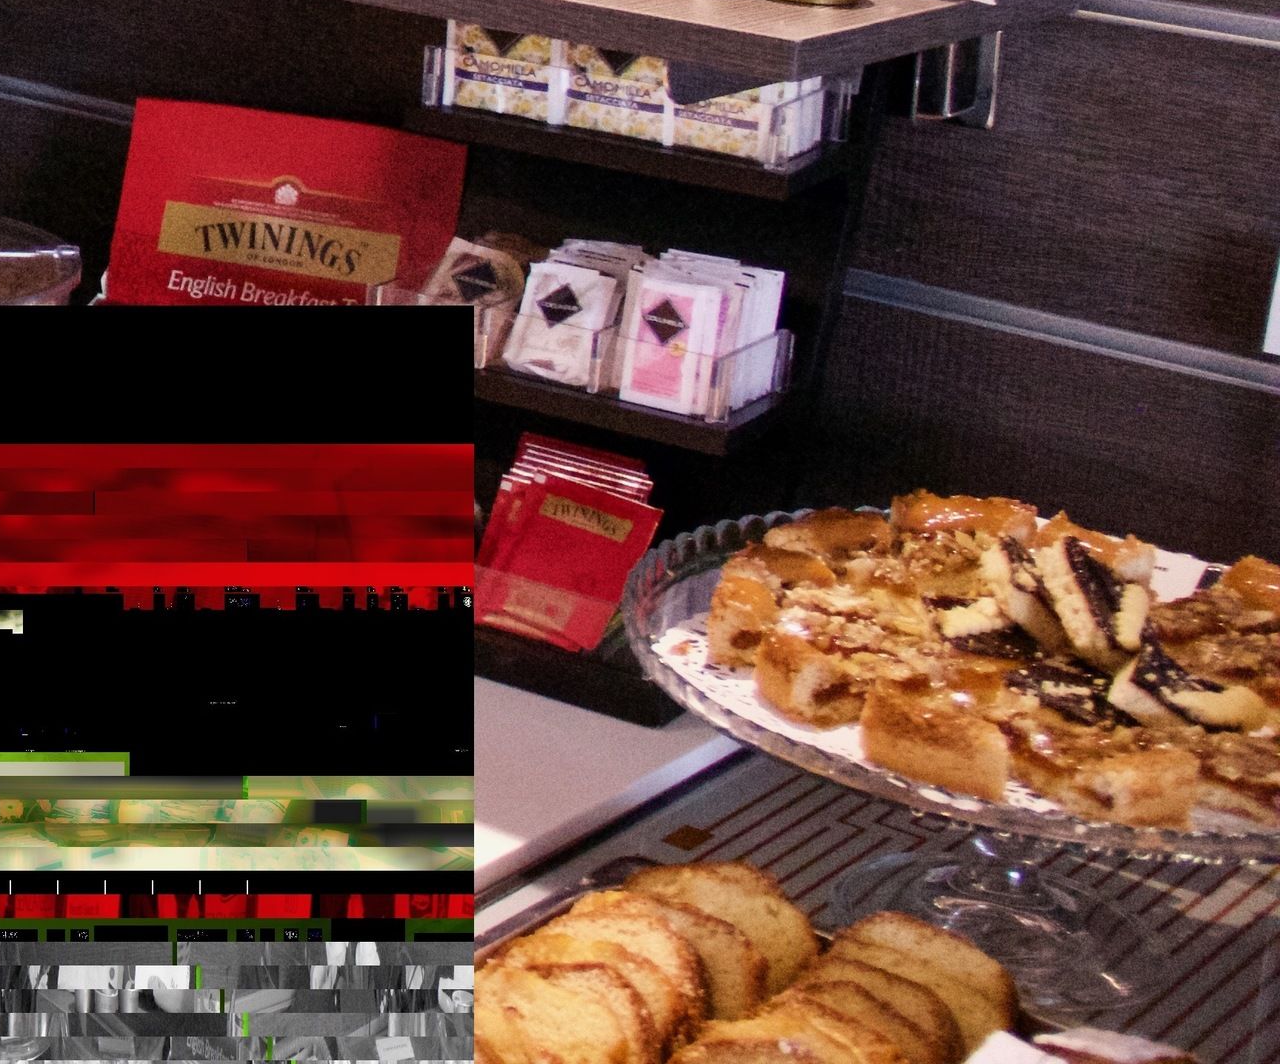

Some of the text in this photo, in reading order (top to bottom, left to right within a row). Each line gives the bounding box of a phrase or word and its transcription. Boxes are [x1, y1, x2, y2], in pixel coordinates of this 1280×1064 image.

[195, 221, 363, 276] TWININGS
[245, 253, 304, 268] OF LONDON
[167, 269, 237, 299] English
